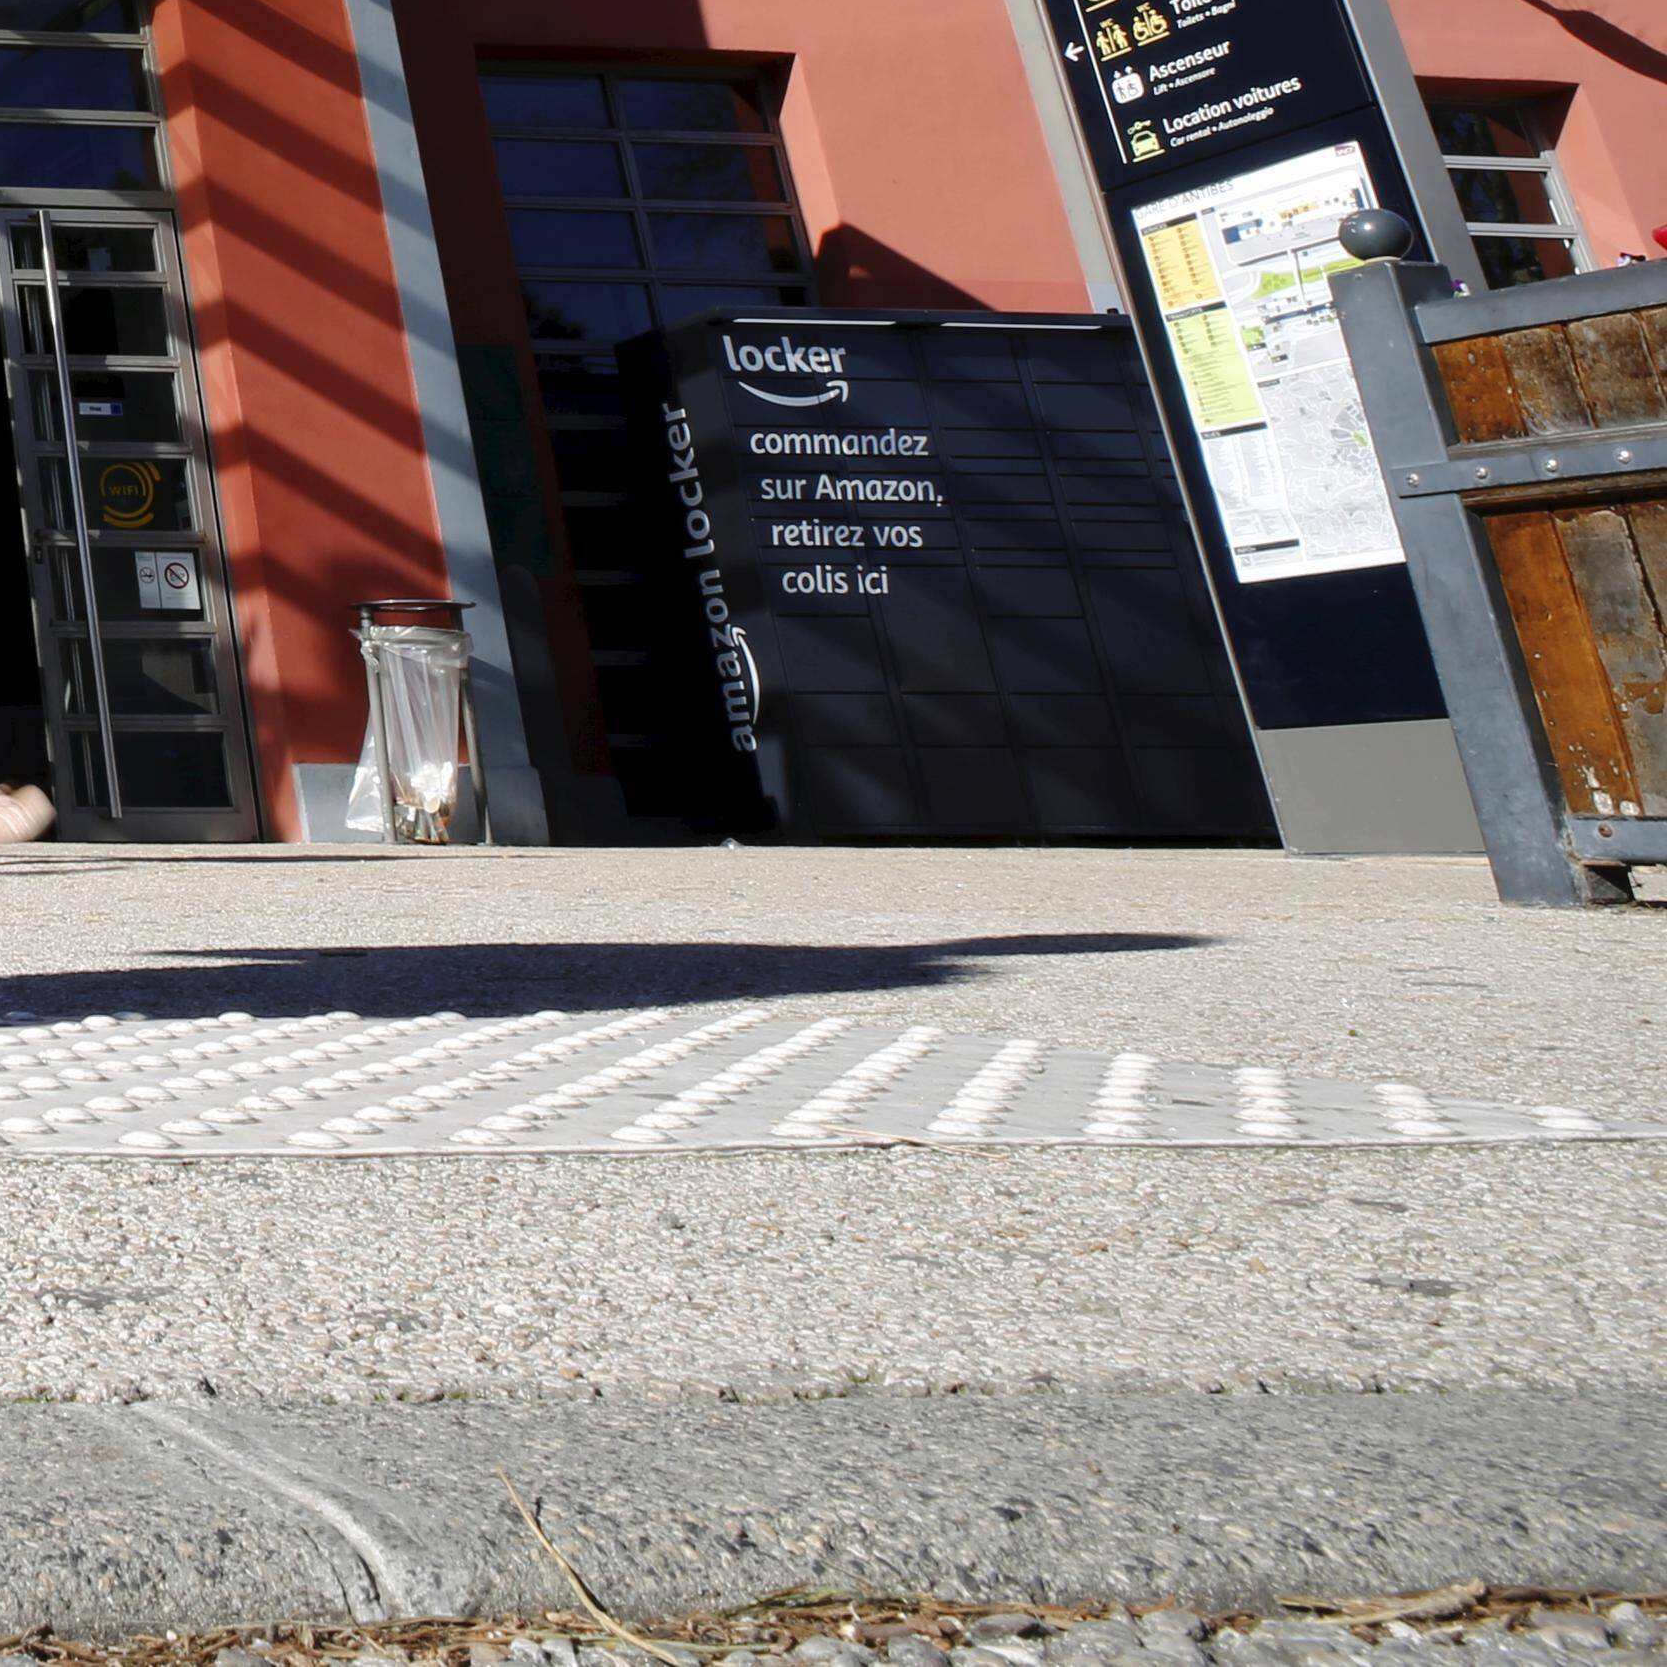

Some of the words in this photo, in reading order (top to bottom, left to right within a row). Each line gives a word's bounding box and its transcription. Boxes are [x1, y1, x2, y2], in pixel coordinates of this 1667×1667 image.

[1176, 12, 1205, 29] Toilets
[1211, 0, 1237, 16] Bagni
[1148, 40, 1231, 82] Ascenseur
[1153, 83, 1168, 96] Lift
[1174, 67, 1216, 88] Ascensore
[1162, 99, 1232, 134] Location
[1232, 76, 1302, 110] voitures
[1170, 135, 1185, 148] Car
[1186, 125, 1212, 142] rental
[1217, 106, 1274, 132] Autonoleggio
[723, 335, 846, 373] locker
[750, 428, 929, 456] commandez
[109, 485, 140, 496] WIFI
[662, 402, 715, 560] locker
[761, 477, 806, 500] sur
[771, 519, 865, 547] retirez
[873, 525, 924, 547] vos
[782, 565, 849, 594] colis
[856, 565, 889, 594] ici
[699, 569, 758, 754] amazon
